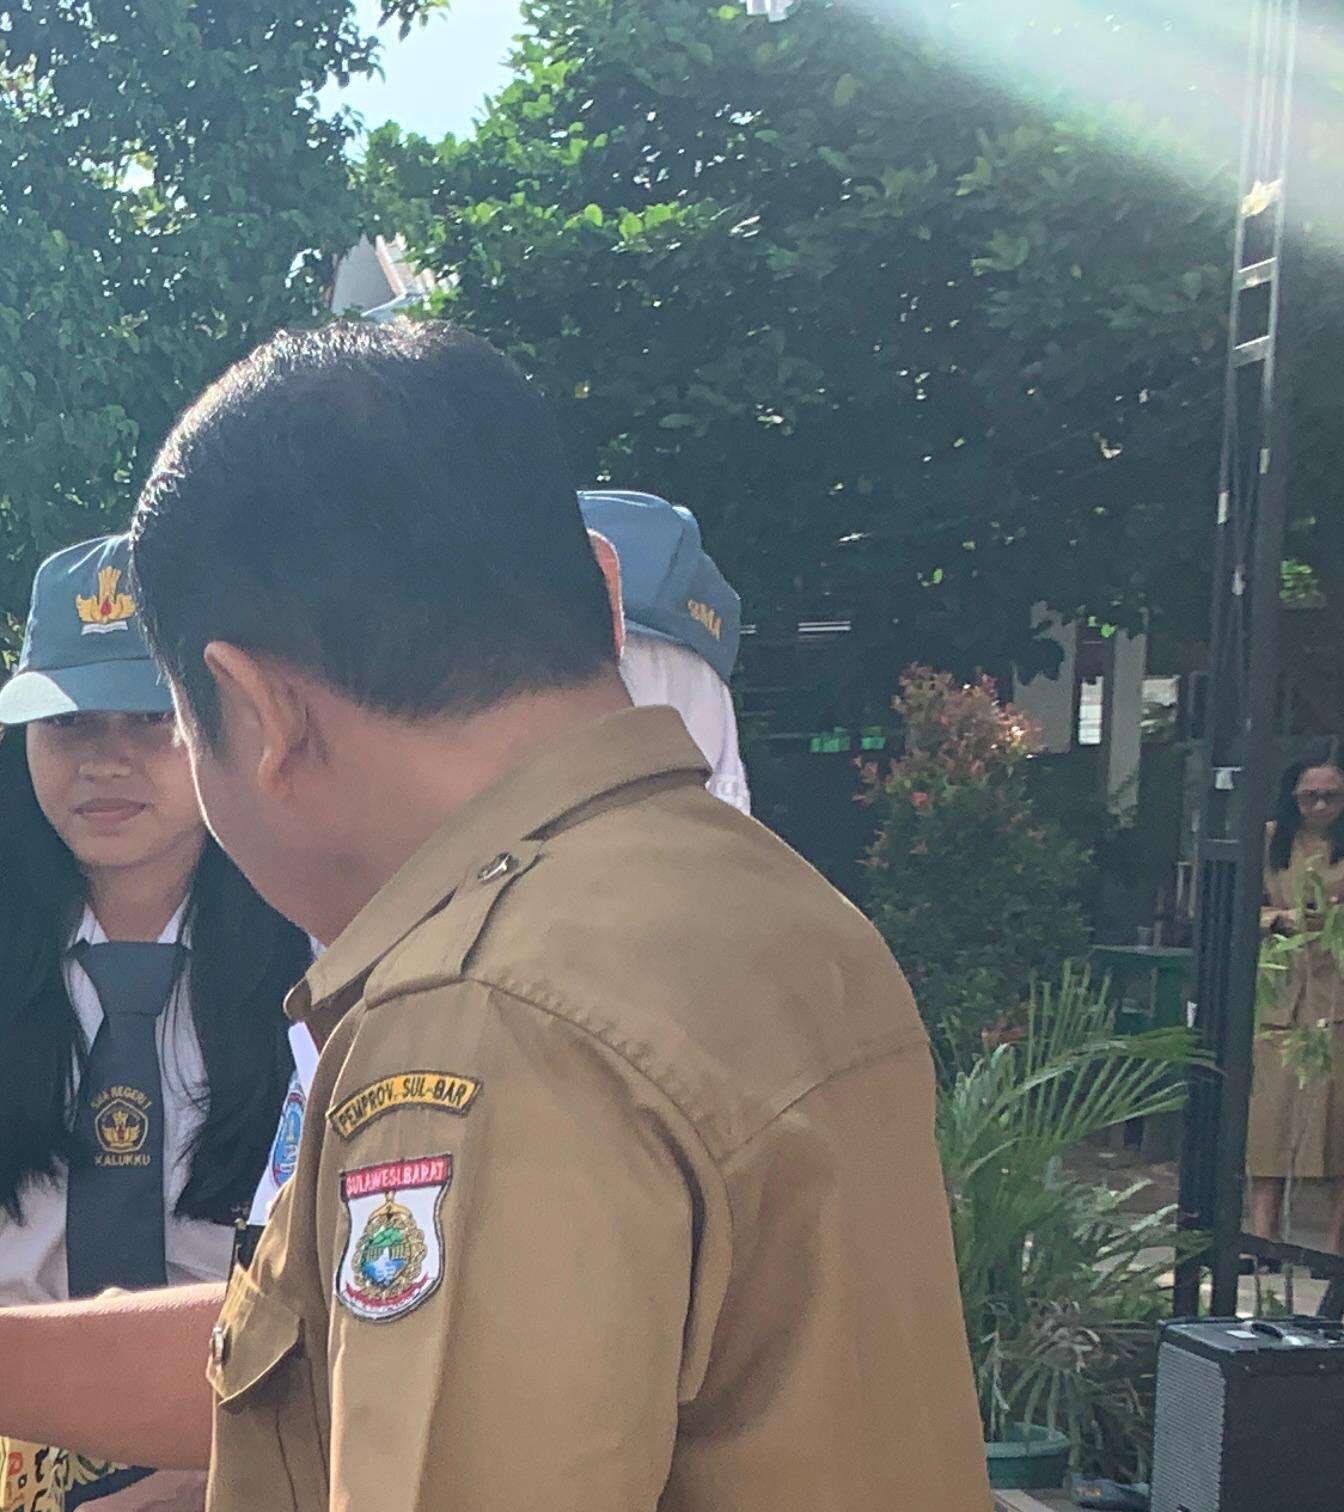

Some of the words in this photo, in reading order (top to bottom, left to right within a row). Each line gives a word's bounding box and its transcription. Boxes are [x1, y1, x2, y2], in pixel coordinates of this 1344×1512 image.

[403, 1076, 468, 1106] SUL-BAR
[95, 1153, 151, 1167] KALUKKU
[346, 1166, 402, 1198] SULAWESI
[403, 1160, 445, 1185] BARAT
